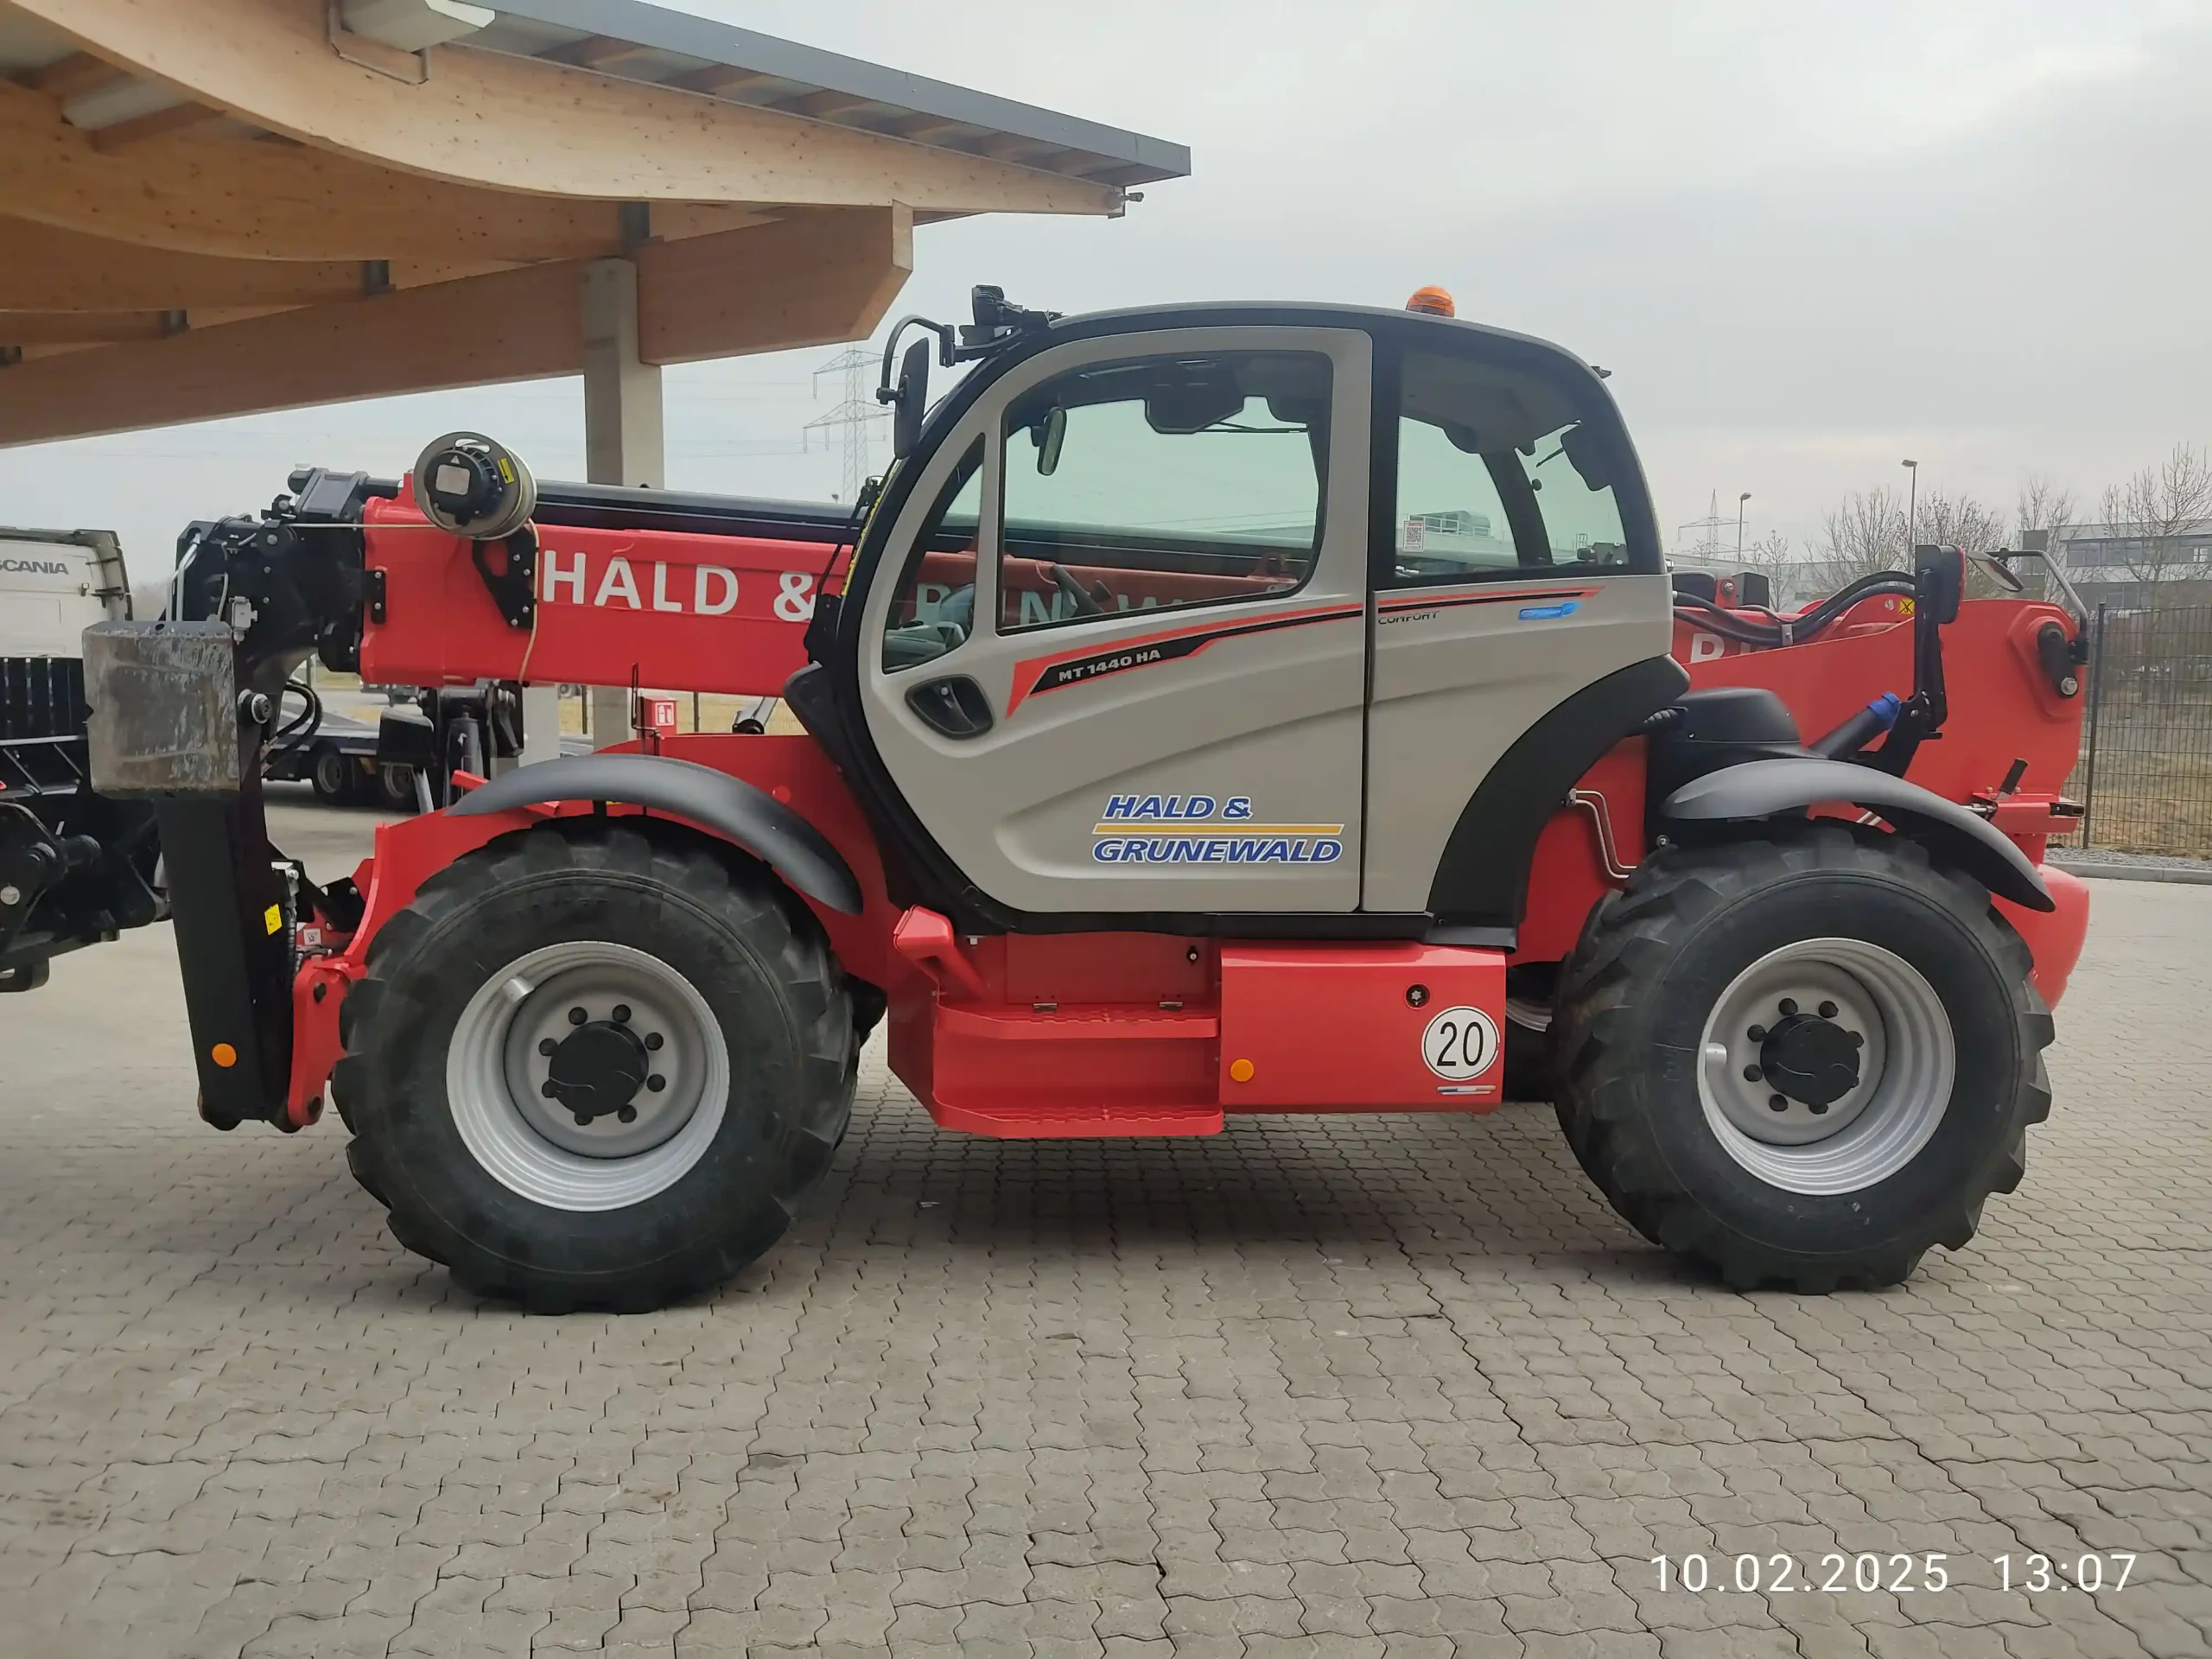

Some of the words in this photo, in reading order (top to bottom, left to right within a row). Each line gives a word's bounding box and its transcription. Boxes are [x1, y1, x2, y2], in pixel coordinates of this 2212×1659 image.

[543, 550, 739, 615] HALD
[772, 570, 817, 622] &
[1378, 610, 1440, 625] COMFORT
[1058, 666, 1084, 682] MT
[1087, 655, 1132, 675] 1440
[1136, 649, 1161, 664] HA
[1103, 794, 1216, 819] HALD
[1221, 797, 1253, 820] &
[1092, 838, 1344, 863] GRUNEWALD
[1436, 1021, 1484, 1066] 20
